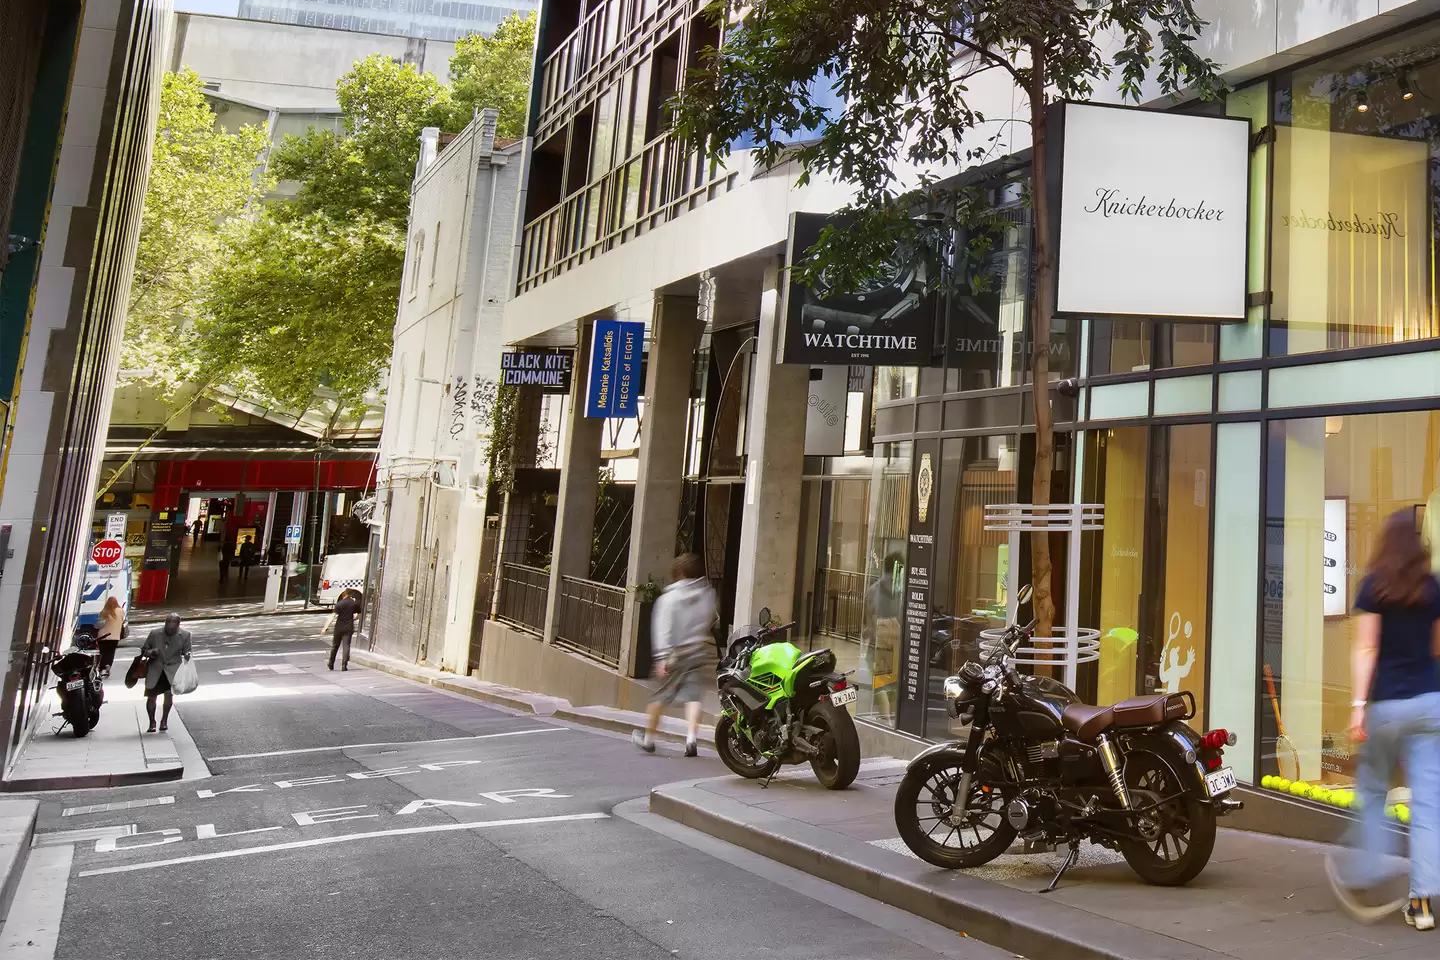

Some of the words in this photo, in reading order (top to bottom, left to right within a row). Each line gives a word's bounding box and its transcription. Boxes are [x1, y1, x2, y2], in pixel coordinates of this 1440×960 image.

[1084, 188, 1224, 221] Knickerbocker
[601, 330, 614, 371] Katsalidis
[624, 331, 634, 360] EIGHT
[804, 333, 917, 350] WATCHTIME
[502, 354, 540, 368] BLACK
[545, 355, 570, 369] KITE
[506, 370, 564, 384] COMMUNE
[624, 363, 631, 371] of
[597, 373, 610, 408] Melanie
[619, 374, 630, 409] PIECES
[807, 394, 839, 427] ouie
[94, 548, 120, 558] STOP
[911, 591, 924, 601] ROLEX
[196, 760, 482, 798] KEEP
[95, 788, 574, 852] CLEAR
